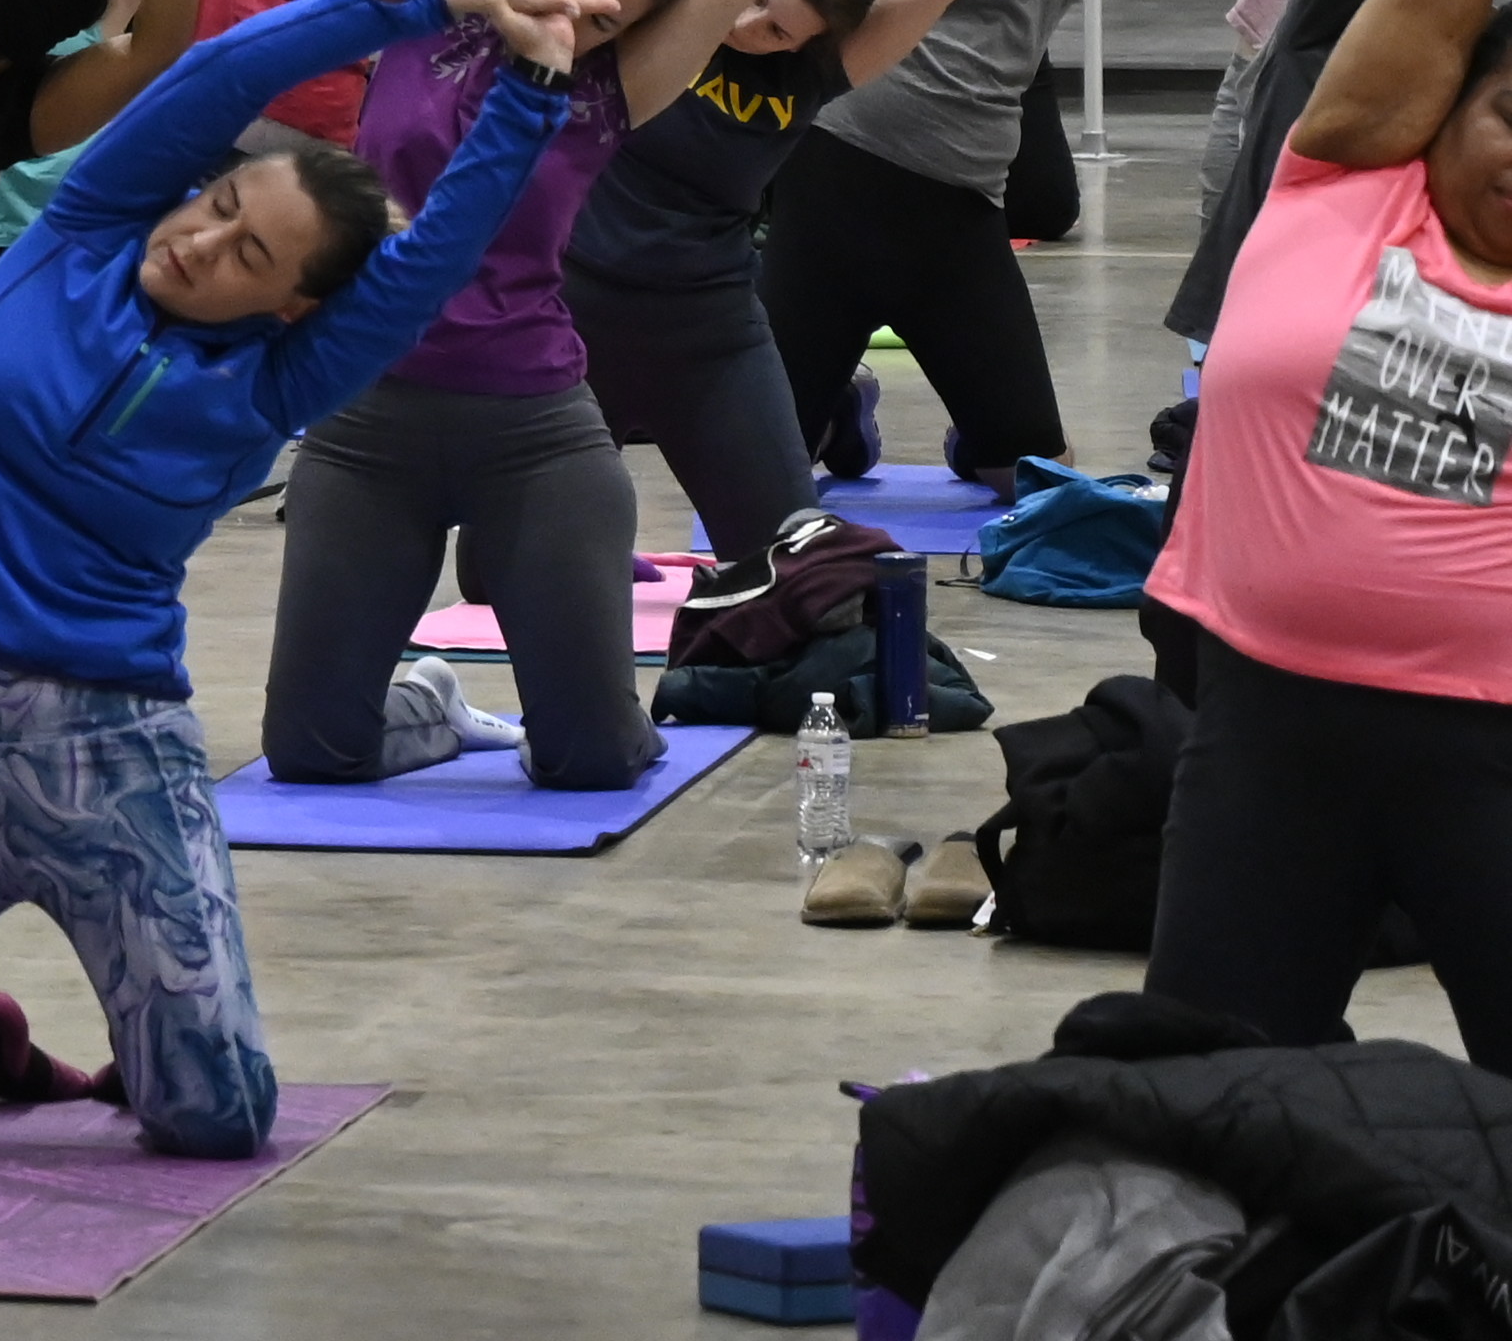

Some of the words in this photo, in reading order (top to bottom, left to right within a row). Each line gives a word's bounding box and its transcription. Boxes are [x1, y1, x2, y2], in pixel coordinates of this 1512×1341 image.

[687, 71, 795, 131] AVY
[1379, 327, 1491, 421] OVER
[1317, 391, 1496, 498] MATTER
